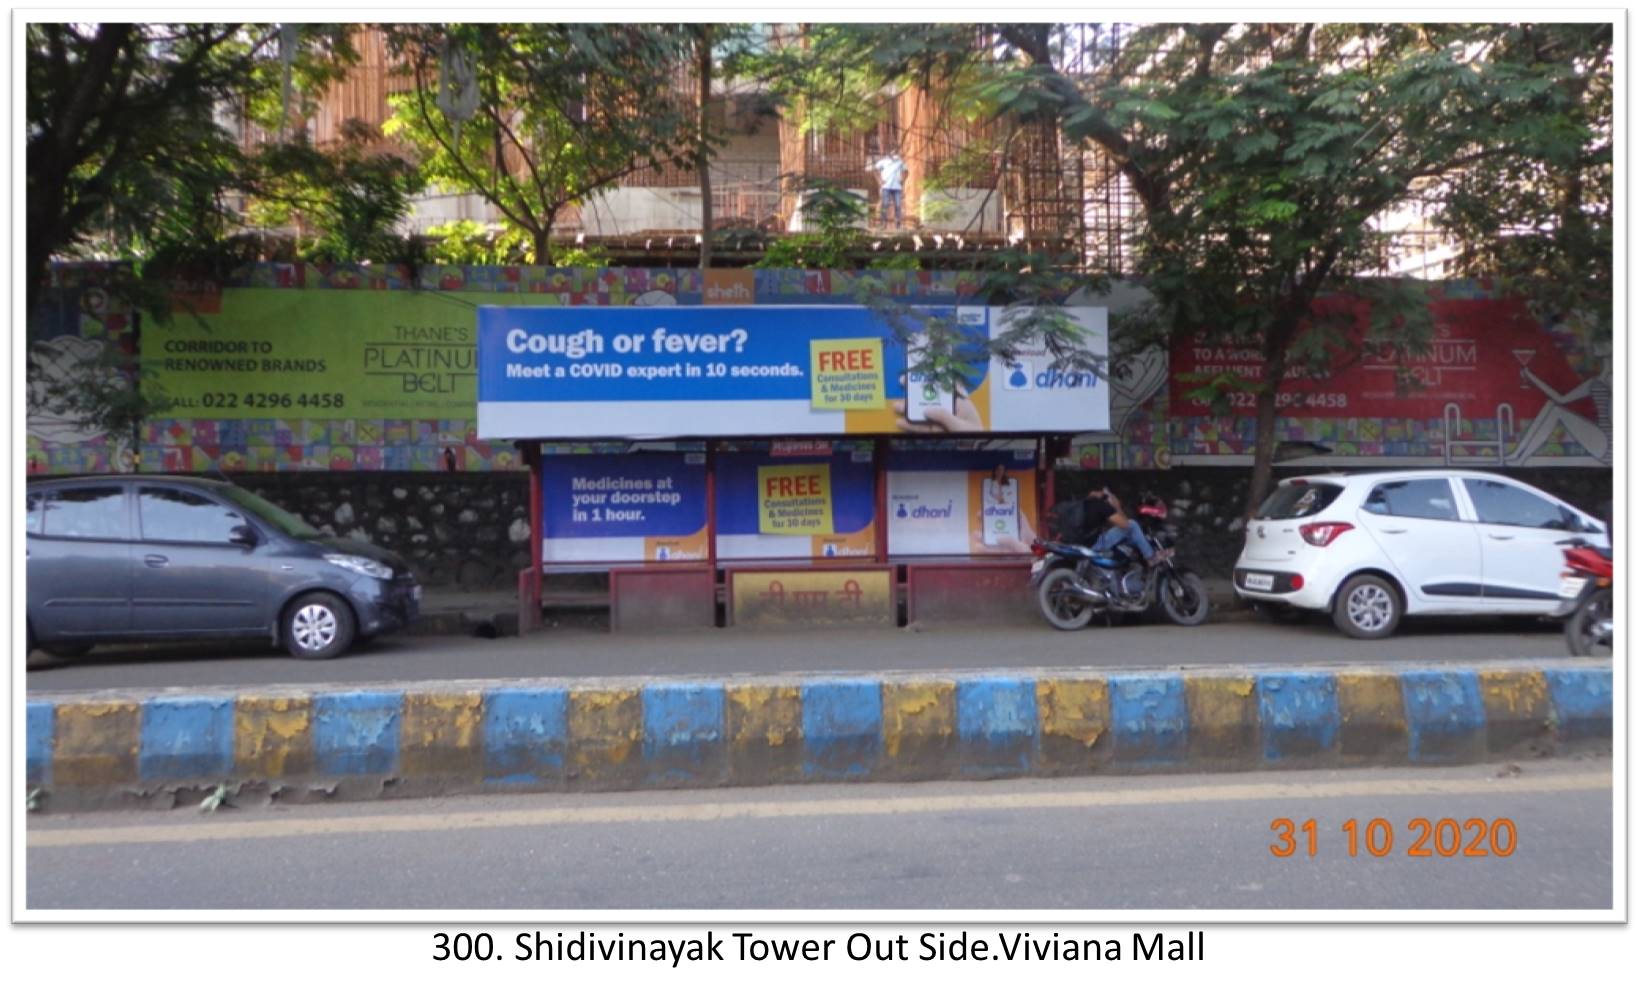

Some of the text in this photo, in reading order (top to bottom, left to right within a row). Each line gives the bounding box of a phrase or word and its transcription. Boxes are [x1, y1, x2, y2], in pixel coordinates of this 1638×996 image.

[707, 281, 750, 299] sheth
[394, 326, 468, 341] THANE'S
[164, 340, 272, 355] CORRIDOR TO
[506, 328, 748, 359] Cough or fever?
[818, 349, 874, 372] FREE
[1228, 348, 1266, 362] WORL
[164, 358, 326, 373] RENOWNED BRANDS
[506, 363, 804, 380] Meet a COVID expert in 10 seconds.
[403, 373, 457, 394] BELT
[818, 372, 878, 383] Consultations
[821, 382, 876, 393] & Medicines
[168, 393, 344, 408] ALL: 022 4296 4458
[824, 394, 837, 403] for
[1306, 392, 1348, 408] 4458
[572, 477, 673, 490] Medicines at
[766, 475, 822, 498] FREE
[572, 491, 681, 507] your doorstep
[764, 498, 826, 509] Consultations
[572, 508, 646, 522] in 1 hour.
[769, 507, 824, 518] & Medicines
[912, 499, 952, 518] dhani
